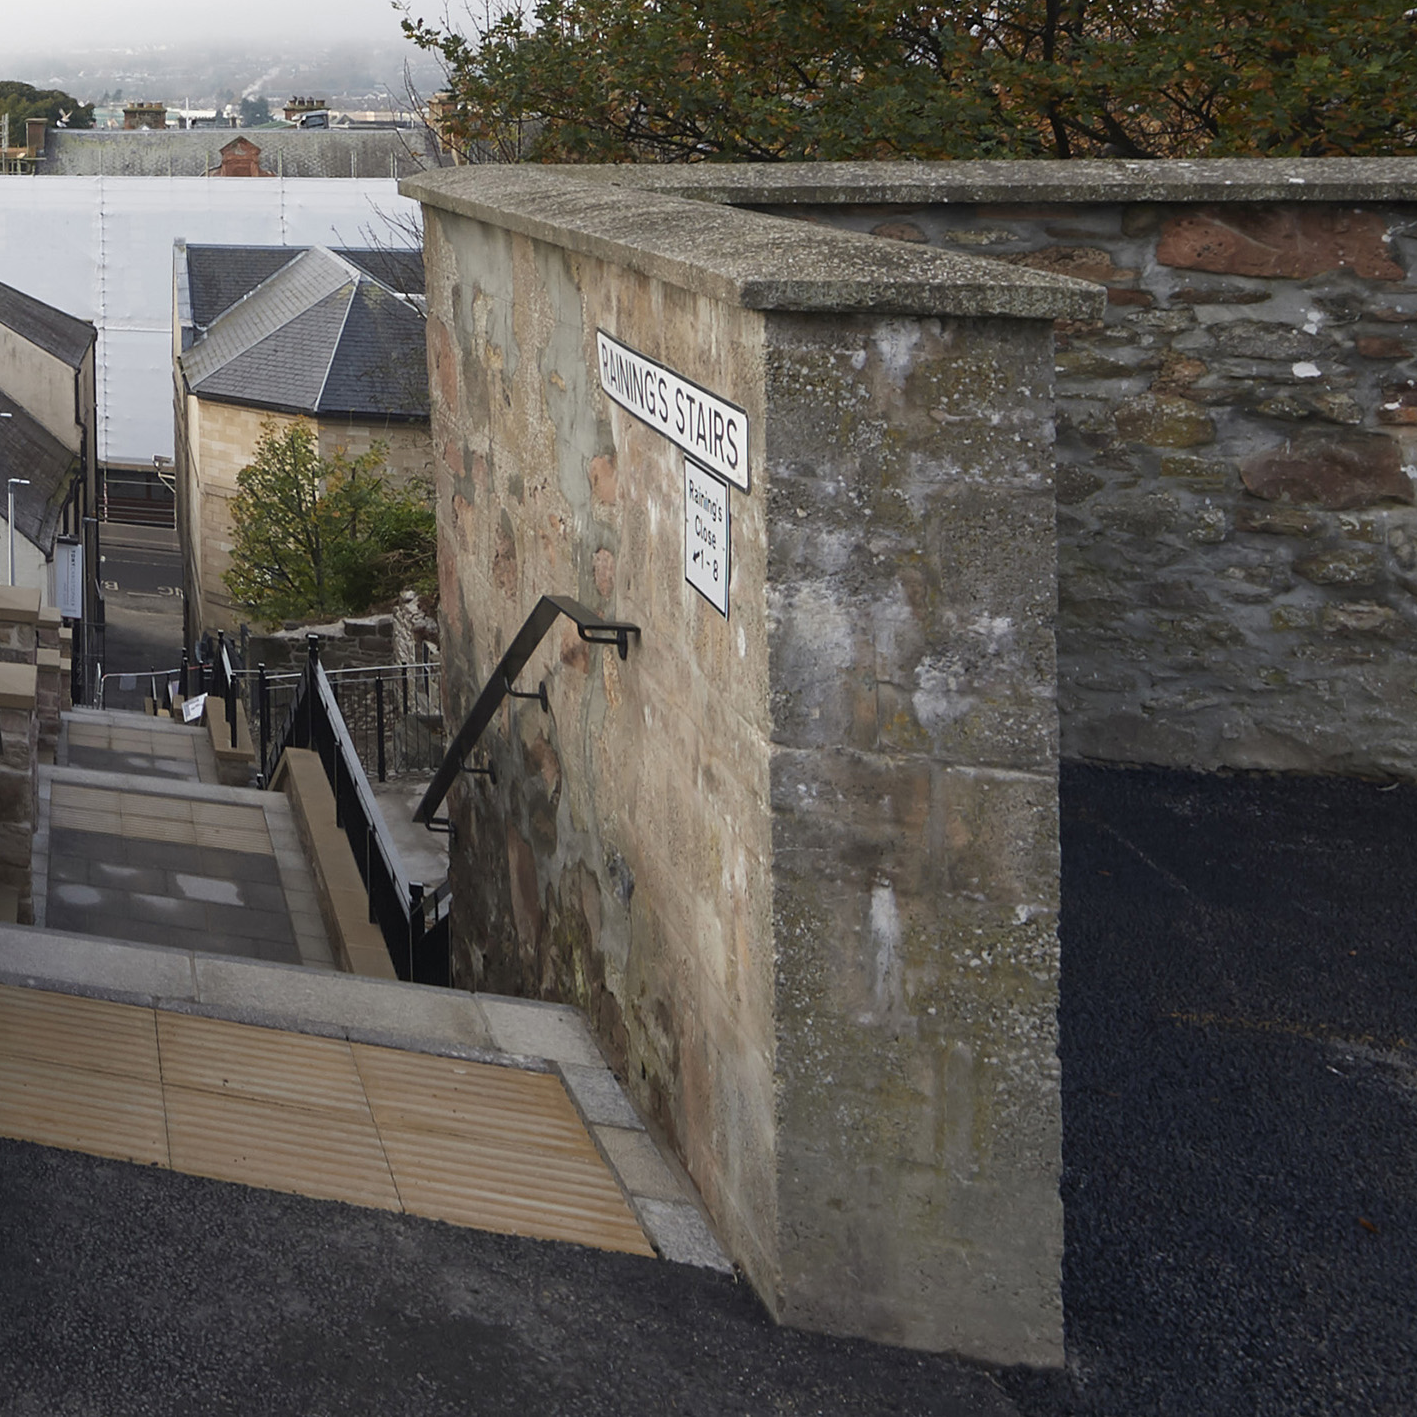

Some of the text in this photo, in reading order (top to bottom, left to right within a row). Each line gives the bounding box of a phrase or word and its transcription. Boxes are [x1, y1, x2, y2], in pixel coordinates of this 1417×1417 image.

[601, 342, 738, 470] RAINING'S STAIRS
[689, 479, 722, 523] Raining's
[694, 514, 717, 550] Close
